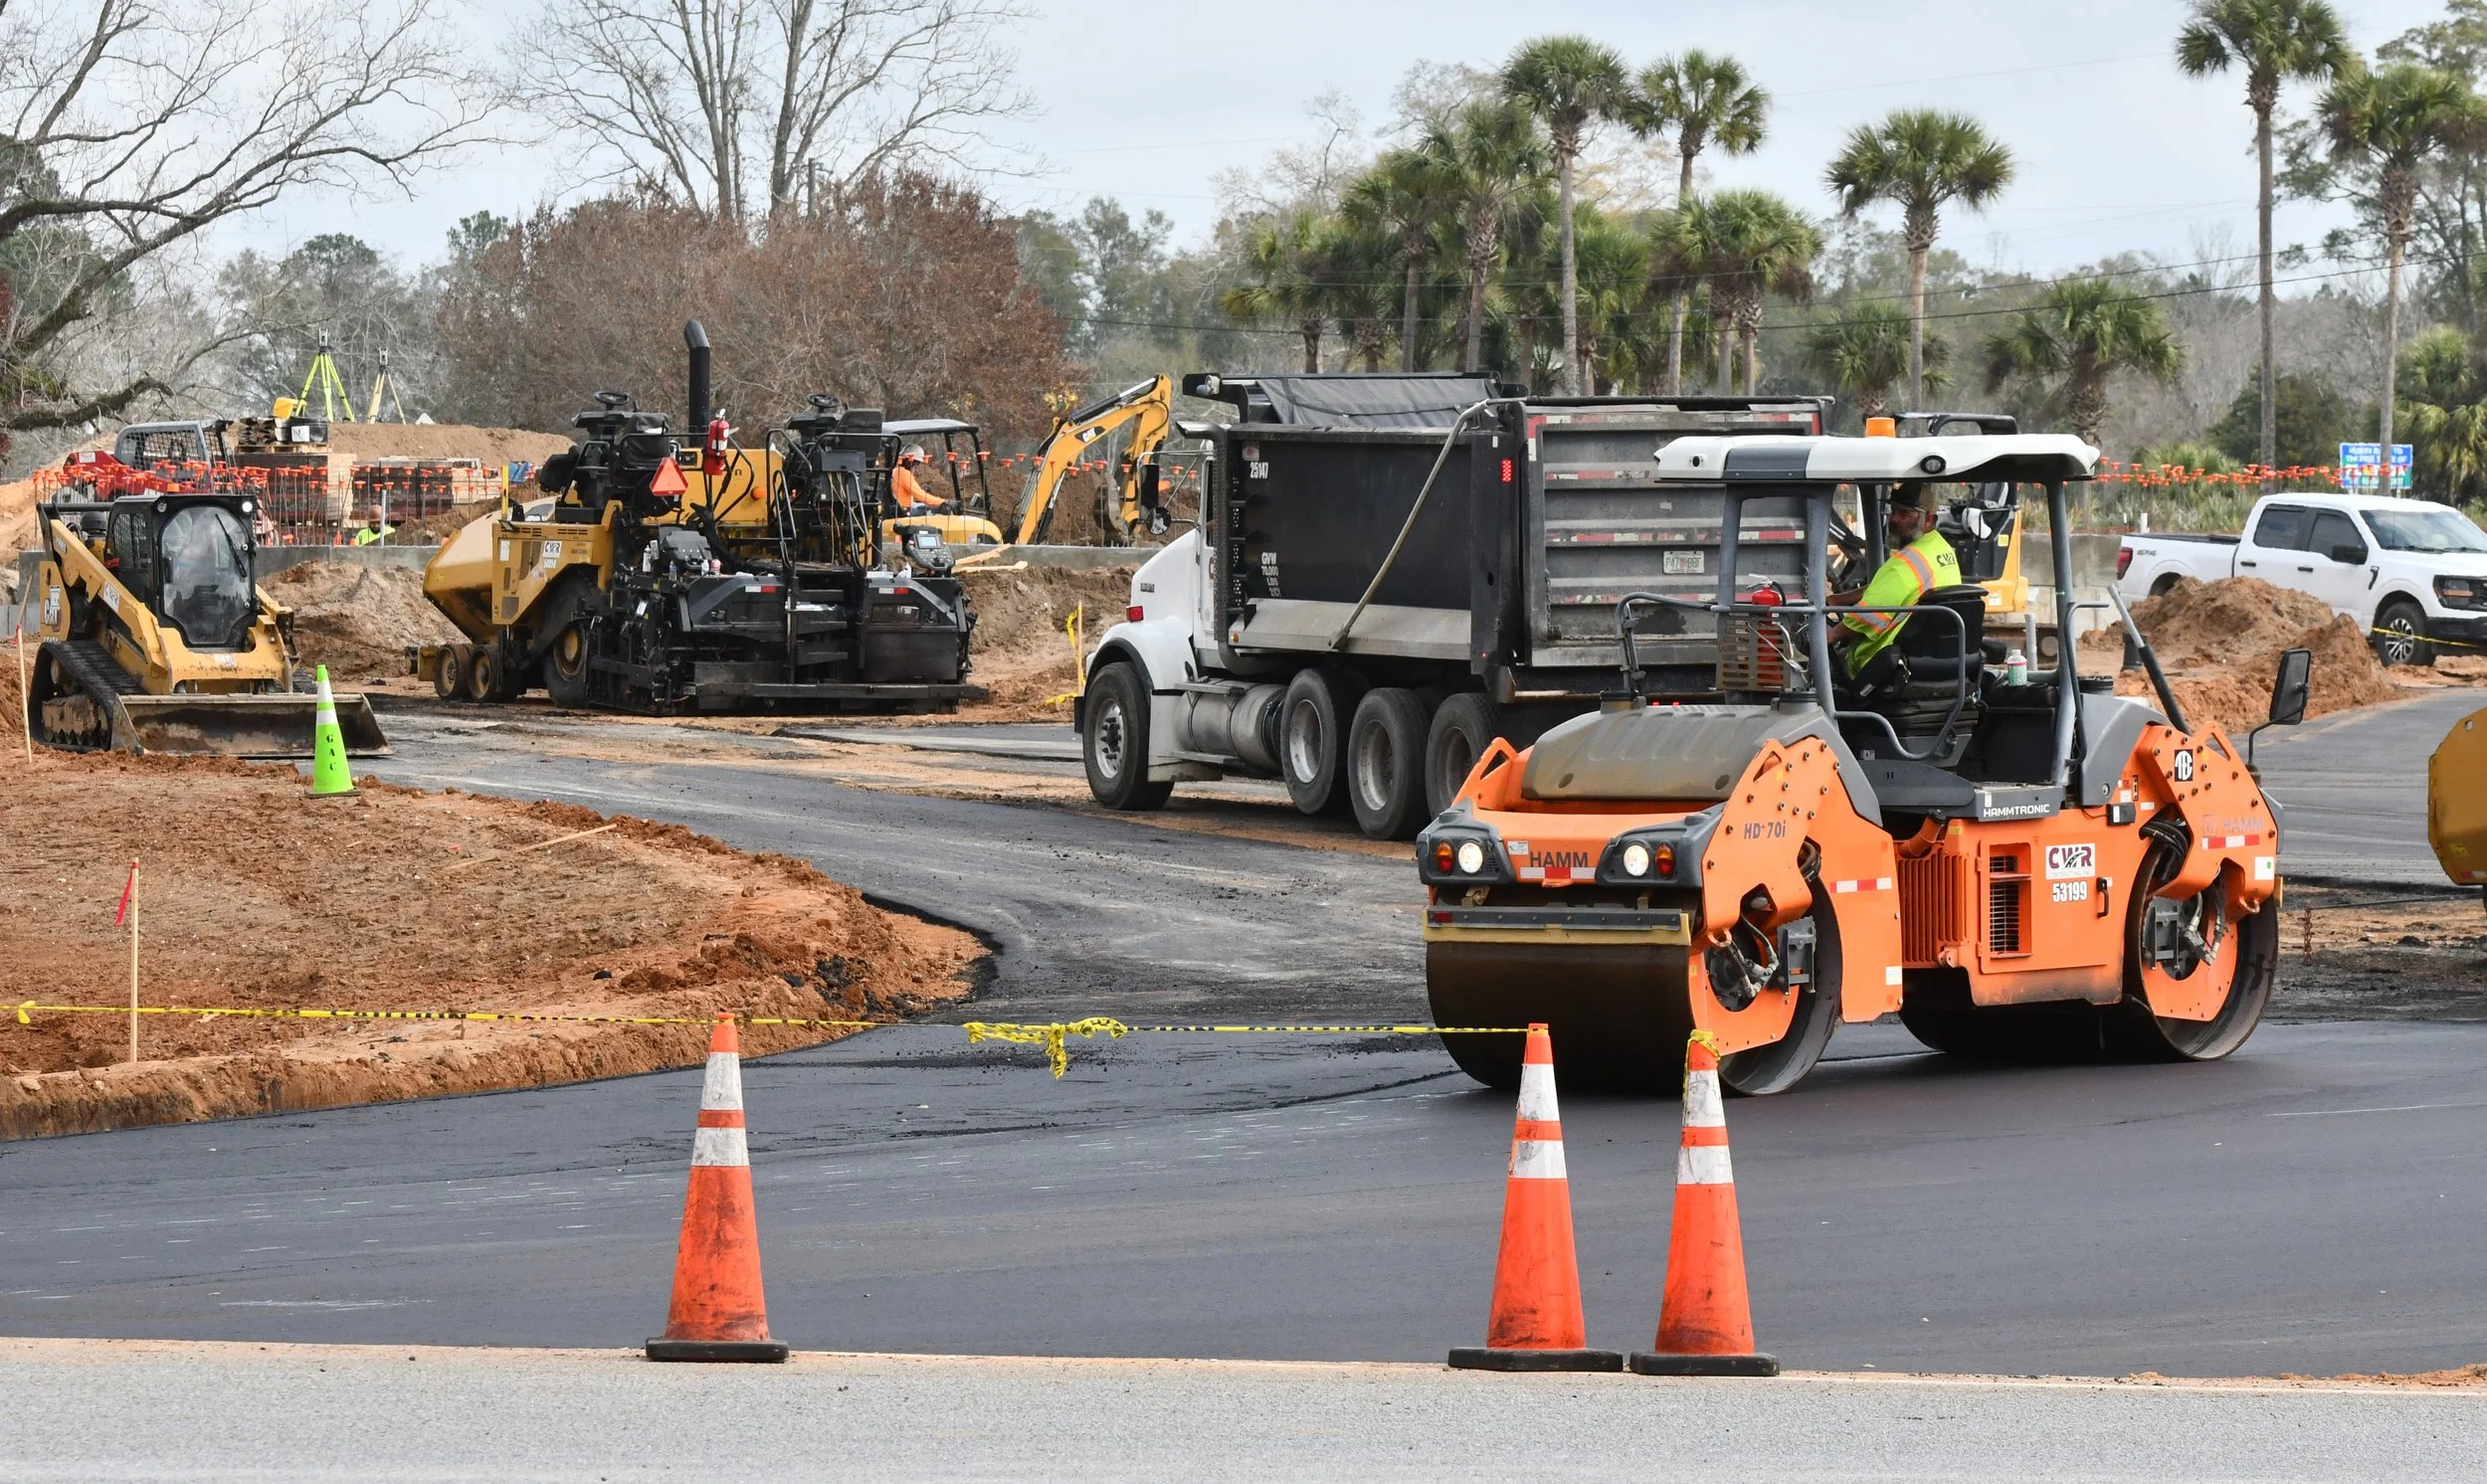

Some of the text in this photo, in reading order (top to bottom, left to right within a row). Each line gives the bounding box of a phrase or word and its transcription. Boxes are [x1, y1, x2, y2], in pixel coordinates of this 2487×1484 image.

[1249, 462, 1268, 478] 25147
[1261, 552, 1277, 565] GVW
[1984, 804, 2050, 818] HAMMTRONIC
[2221, 816, 2264, 834] HAMM
[1529, 851, 1589, 867] HAMM
[2048, 846, 2092, 869] CWR
[2052, 881, 2088, 903] 53199
